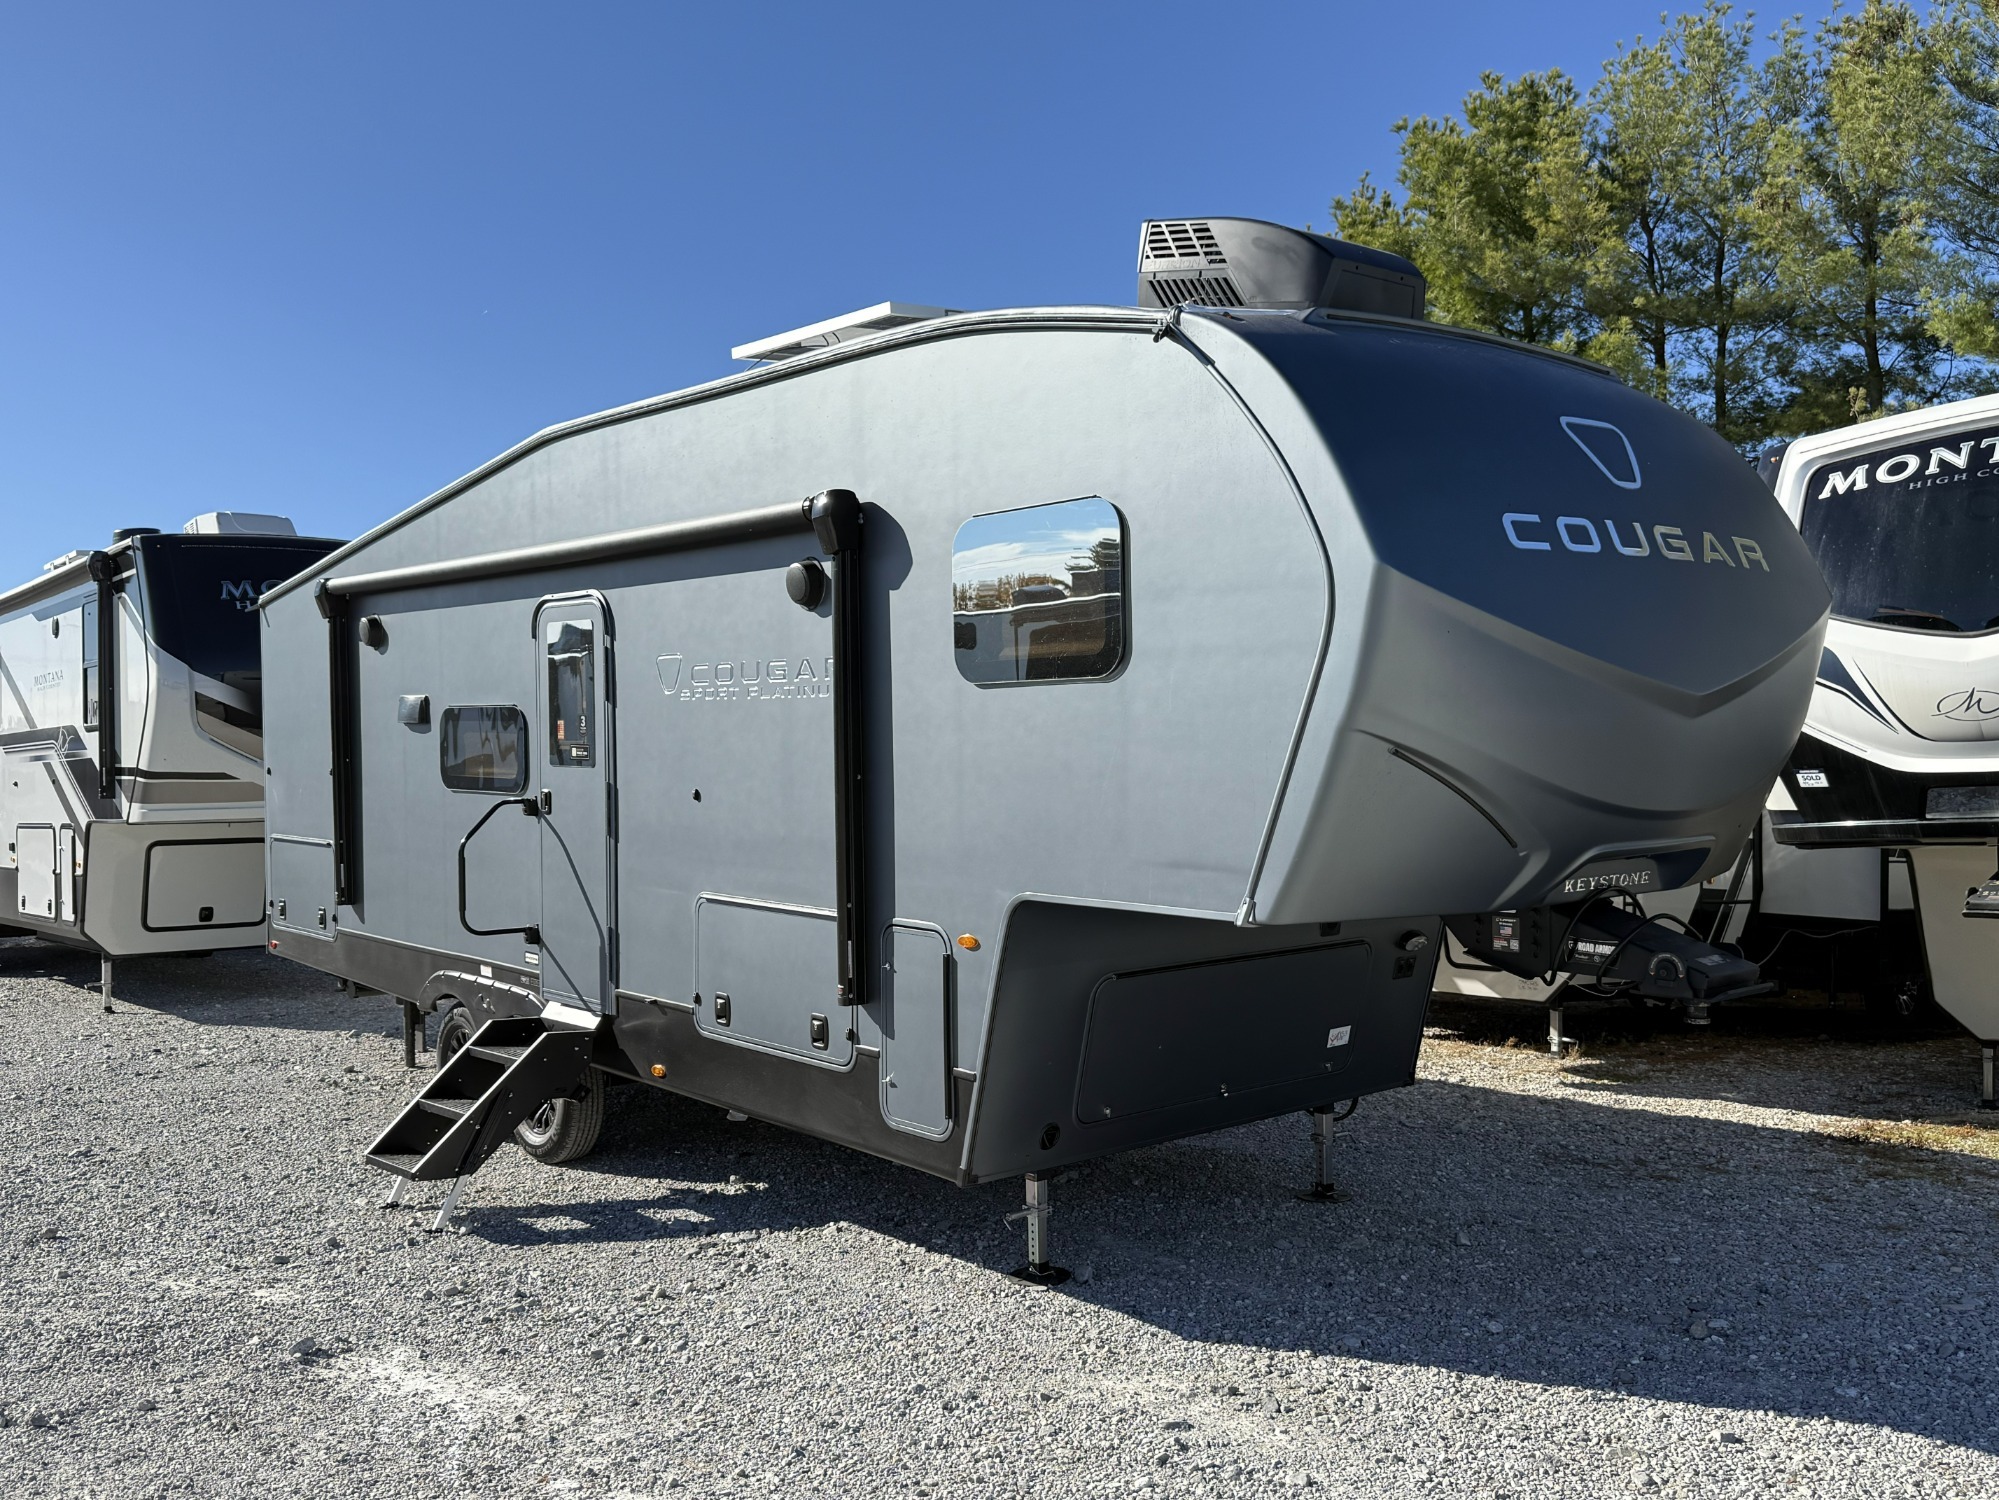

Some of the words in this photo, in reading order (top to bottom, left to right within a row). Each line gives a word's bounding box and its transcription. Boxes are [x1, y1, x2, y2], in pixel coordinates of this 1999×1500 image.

[1909, 472, 1967, 491] HIGH
[1502, 512, 1770, 572] COUGAR
[680, 686, 740, 701] SPORT
[580, 715, 586, 727] 3
[1801, 774, 1822, 782] SOLD
[1564, 870, 1651, 893] KEYSTONE
[1577, 941, 1595, 953] ROAD
